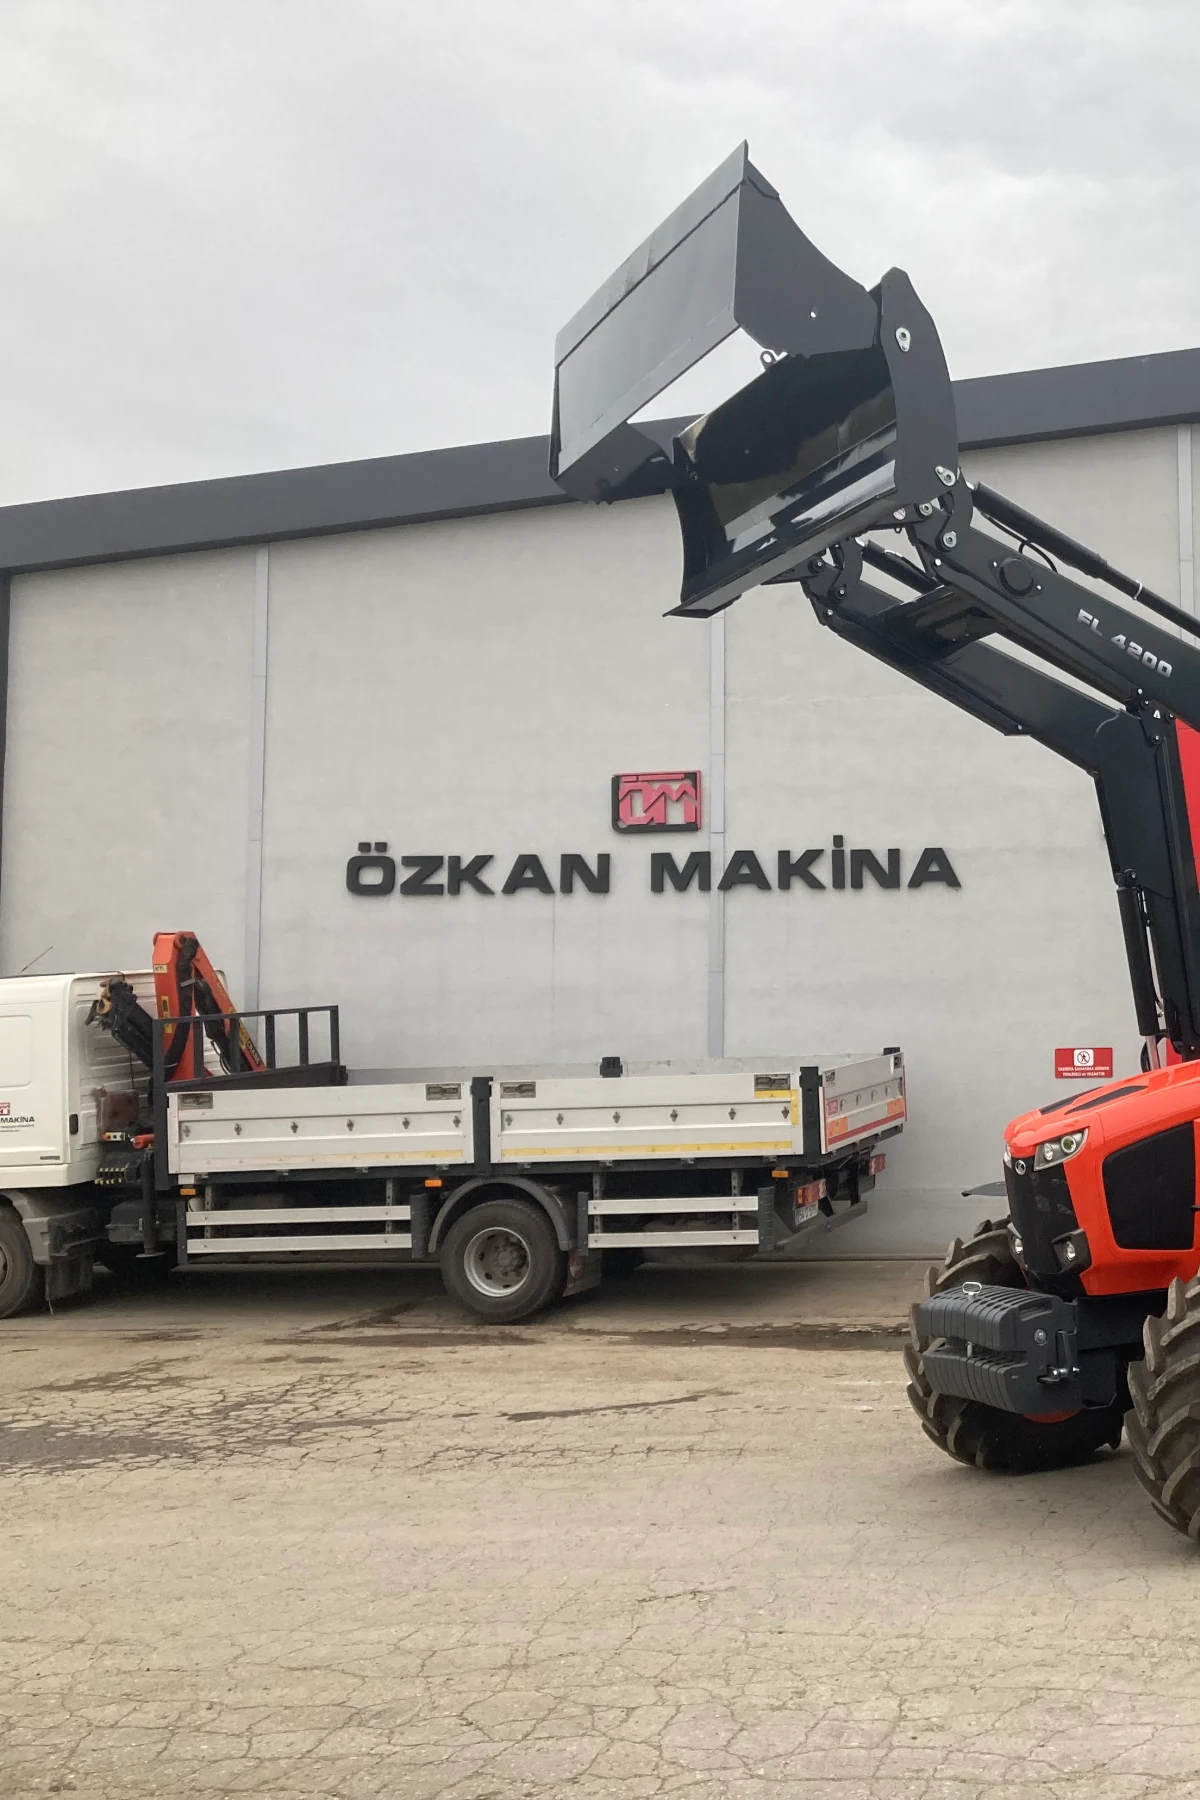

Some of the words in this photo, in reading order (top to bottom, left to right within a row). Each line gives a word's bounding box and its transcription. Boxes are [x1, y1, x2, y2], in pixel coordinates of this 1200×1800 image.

[1077, 609, 1102, 637] FL
[1111, 634, 1172, 678] 4200
[345, 842, 611, 896] ÖZKAN
[650, 834, 962, 892] MAKİNA
